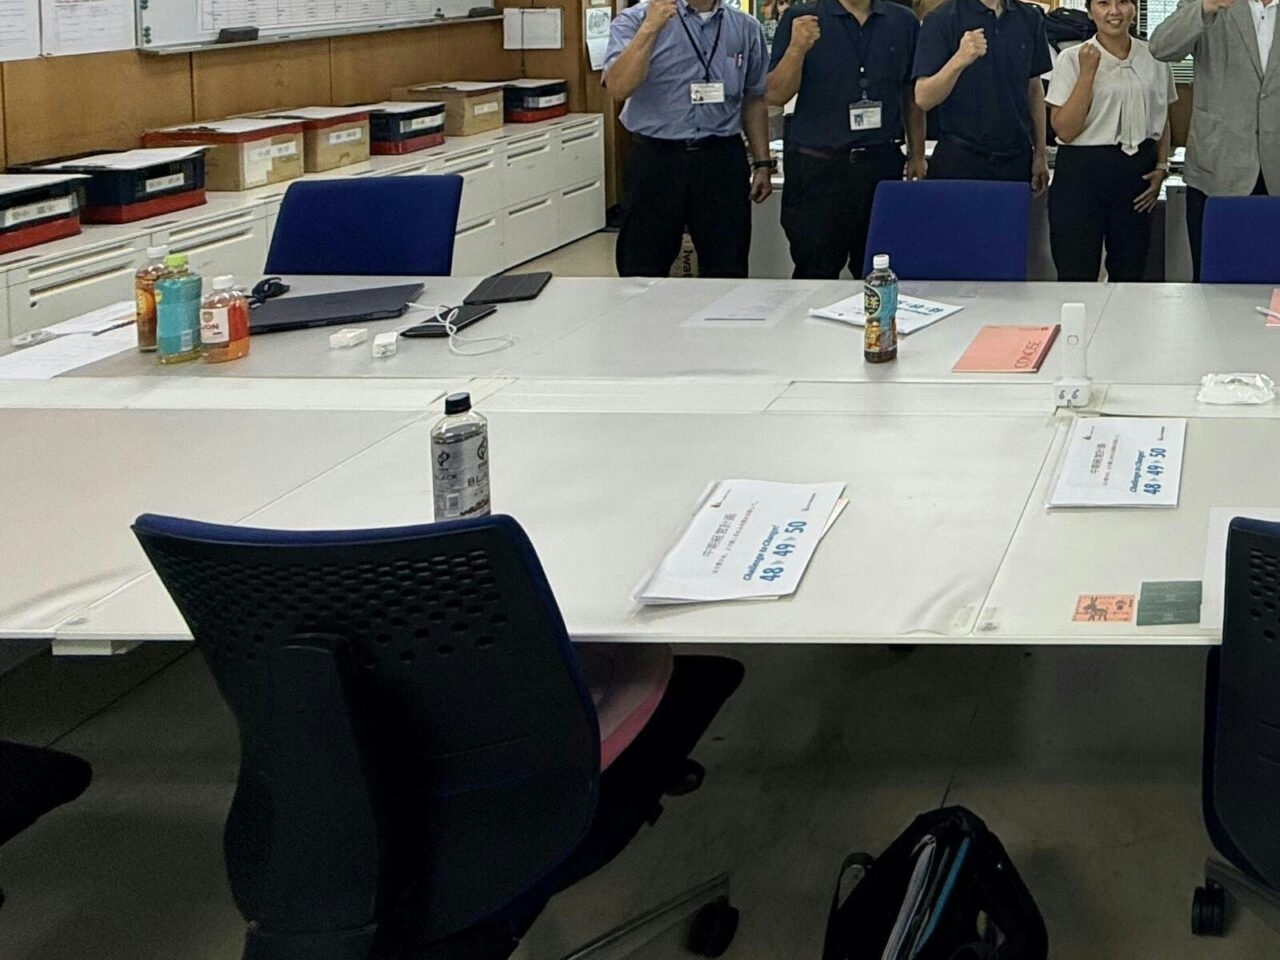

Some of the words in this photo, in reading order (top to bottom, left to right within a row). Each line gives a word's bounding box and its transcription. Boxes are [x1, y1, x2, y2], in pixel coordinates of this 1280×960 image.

[1149, 448, 1167, 458] 50
[1146, 464, 1164, 476] 49
[1143, 483, 1162, 495] 48
[759, 567, 784, 582] 48
[772, 543, 796, 557] 49
[784, 521, 807, 533] 50
